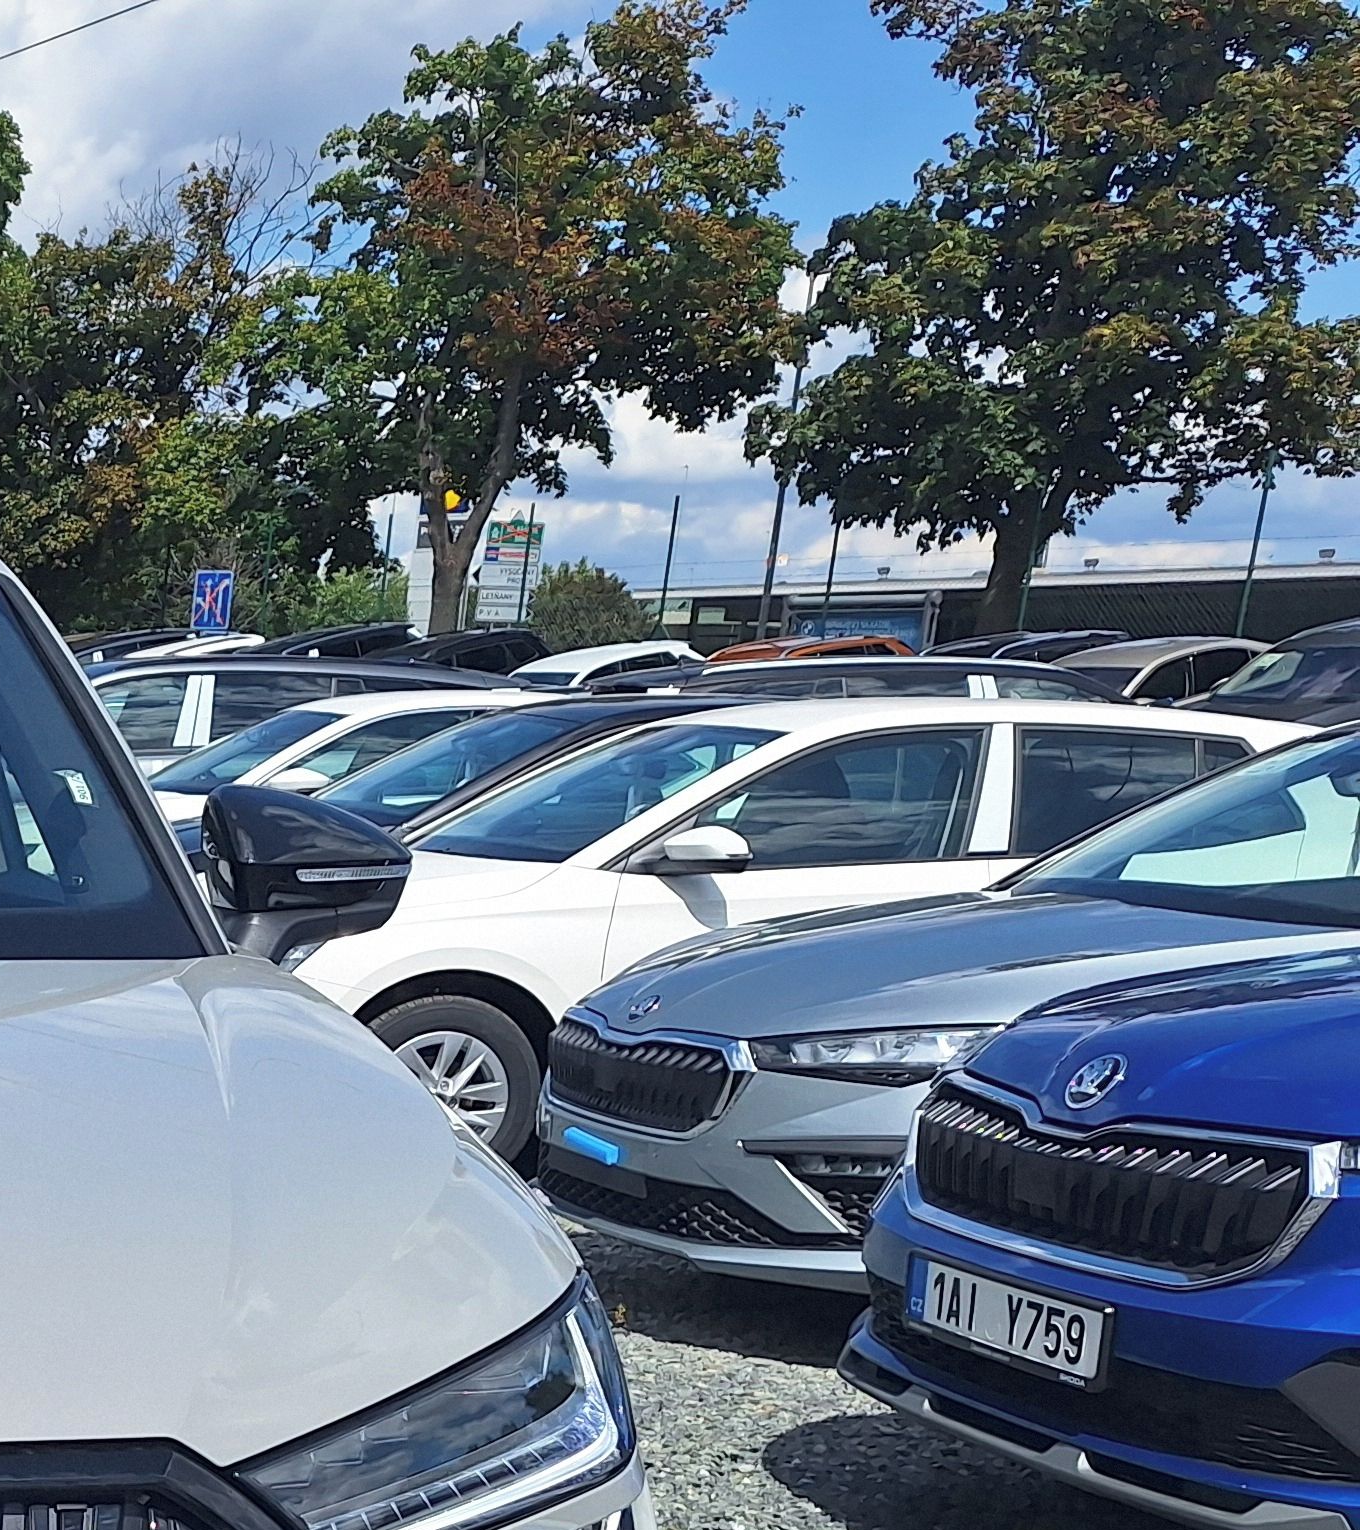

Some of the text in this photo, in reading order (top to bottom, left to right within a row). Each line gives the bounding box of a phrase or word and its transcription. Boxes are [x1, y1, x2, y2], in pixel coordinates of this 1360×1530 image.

[910, 1296, 923, 1312] CZ
[933, 1271, 1086, 1365] 1AI Y759
